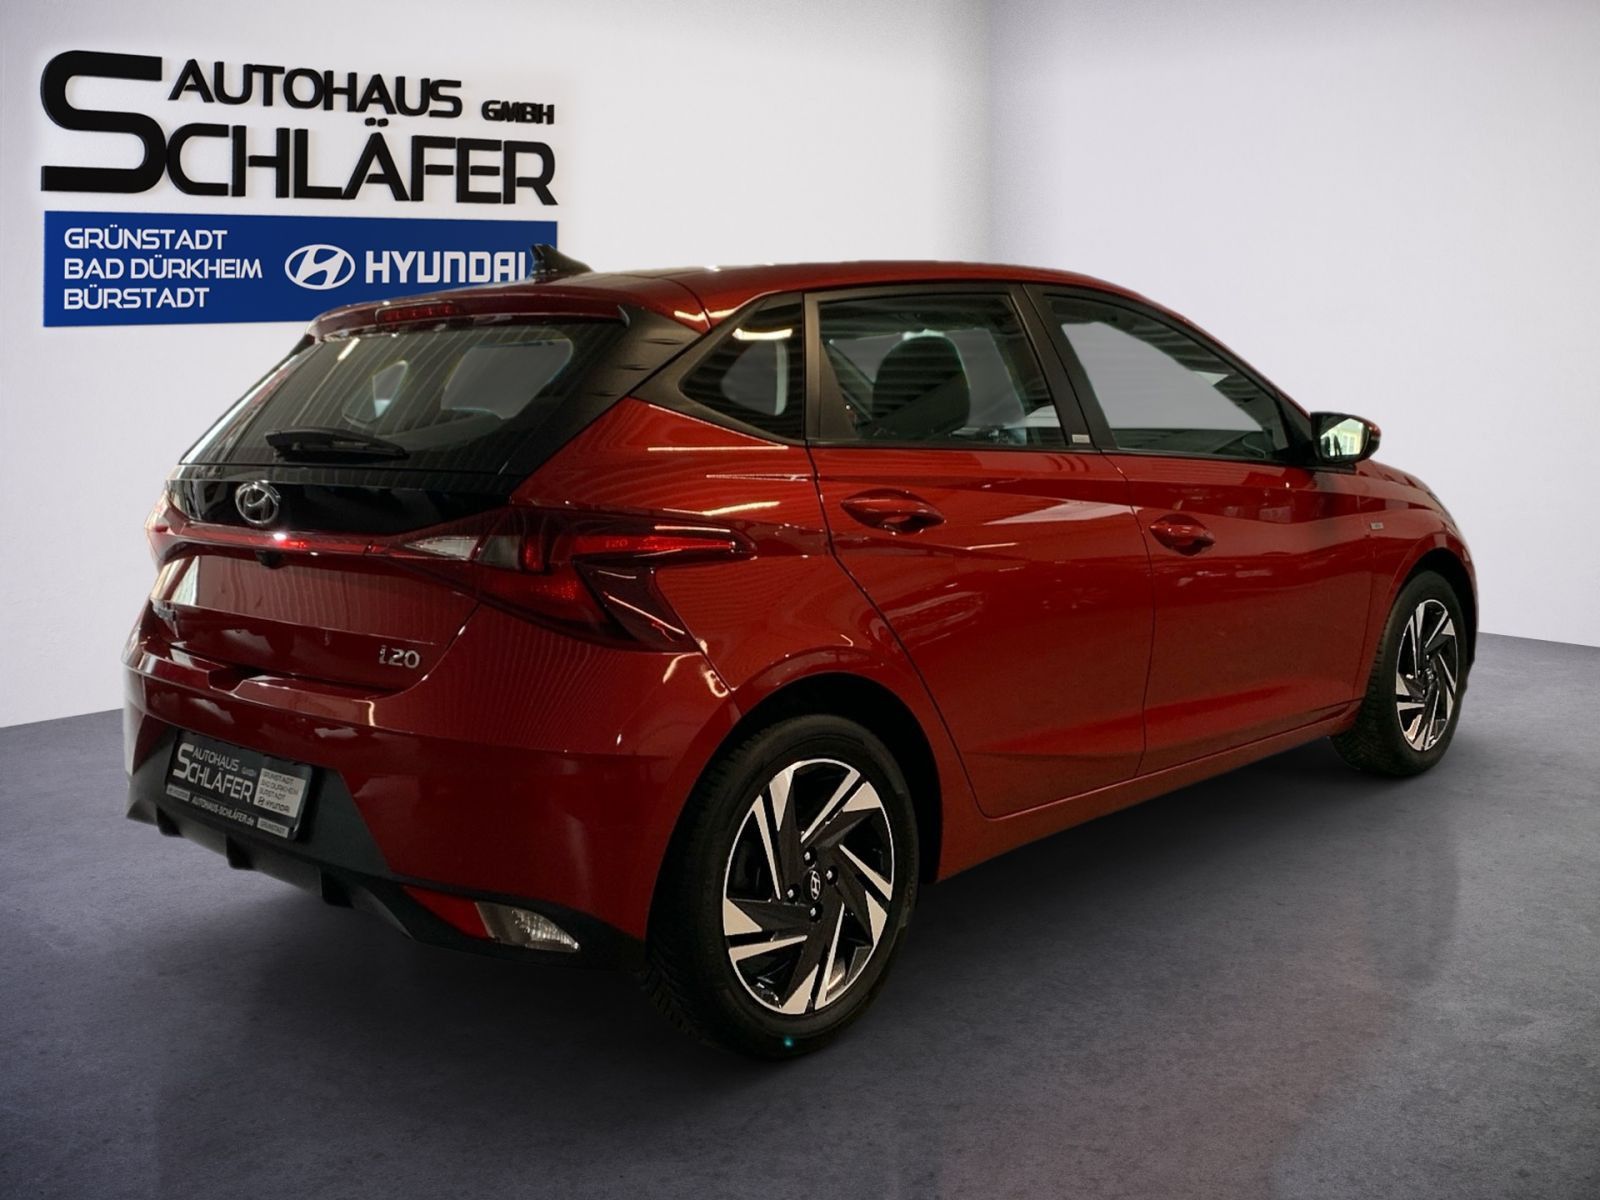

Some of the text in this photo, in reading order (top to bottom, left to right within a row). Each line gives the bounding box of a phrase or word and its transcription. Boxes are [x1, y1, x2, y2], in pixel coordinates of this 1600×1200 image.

[168, 58, 555, 125] AUTOHAUS GMBH
[40, 50, 558, 206] SCHLÄFER
[64, 224, 228, 250] GRÜNSTADT
[64, 254, 263, 279] BAD DÜRKHEIM
[365, 250, 527, 284] HYUNDAI
[64, 284, 210, 310] BÜRSTADT
[379, 644, 420, 669] i20
[172, 742, 254, 803] SCHLÄFER
[192, 747, 240, 772] AUTOHAUS
